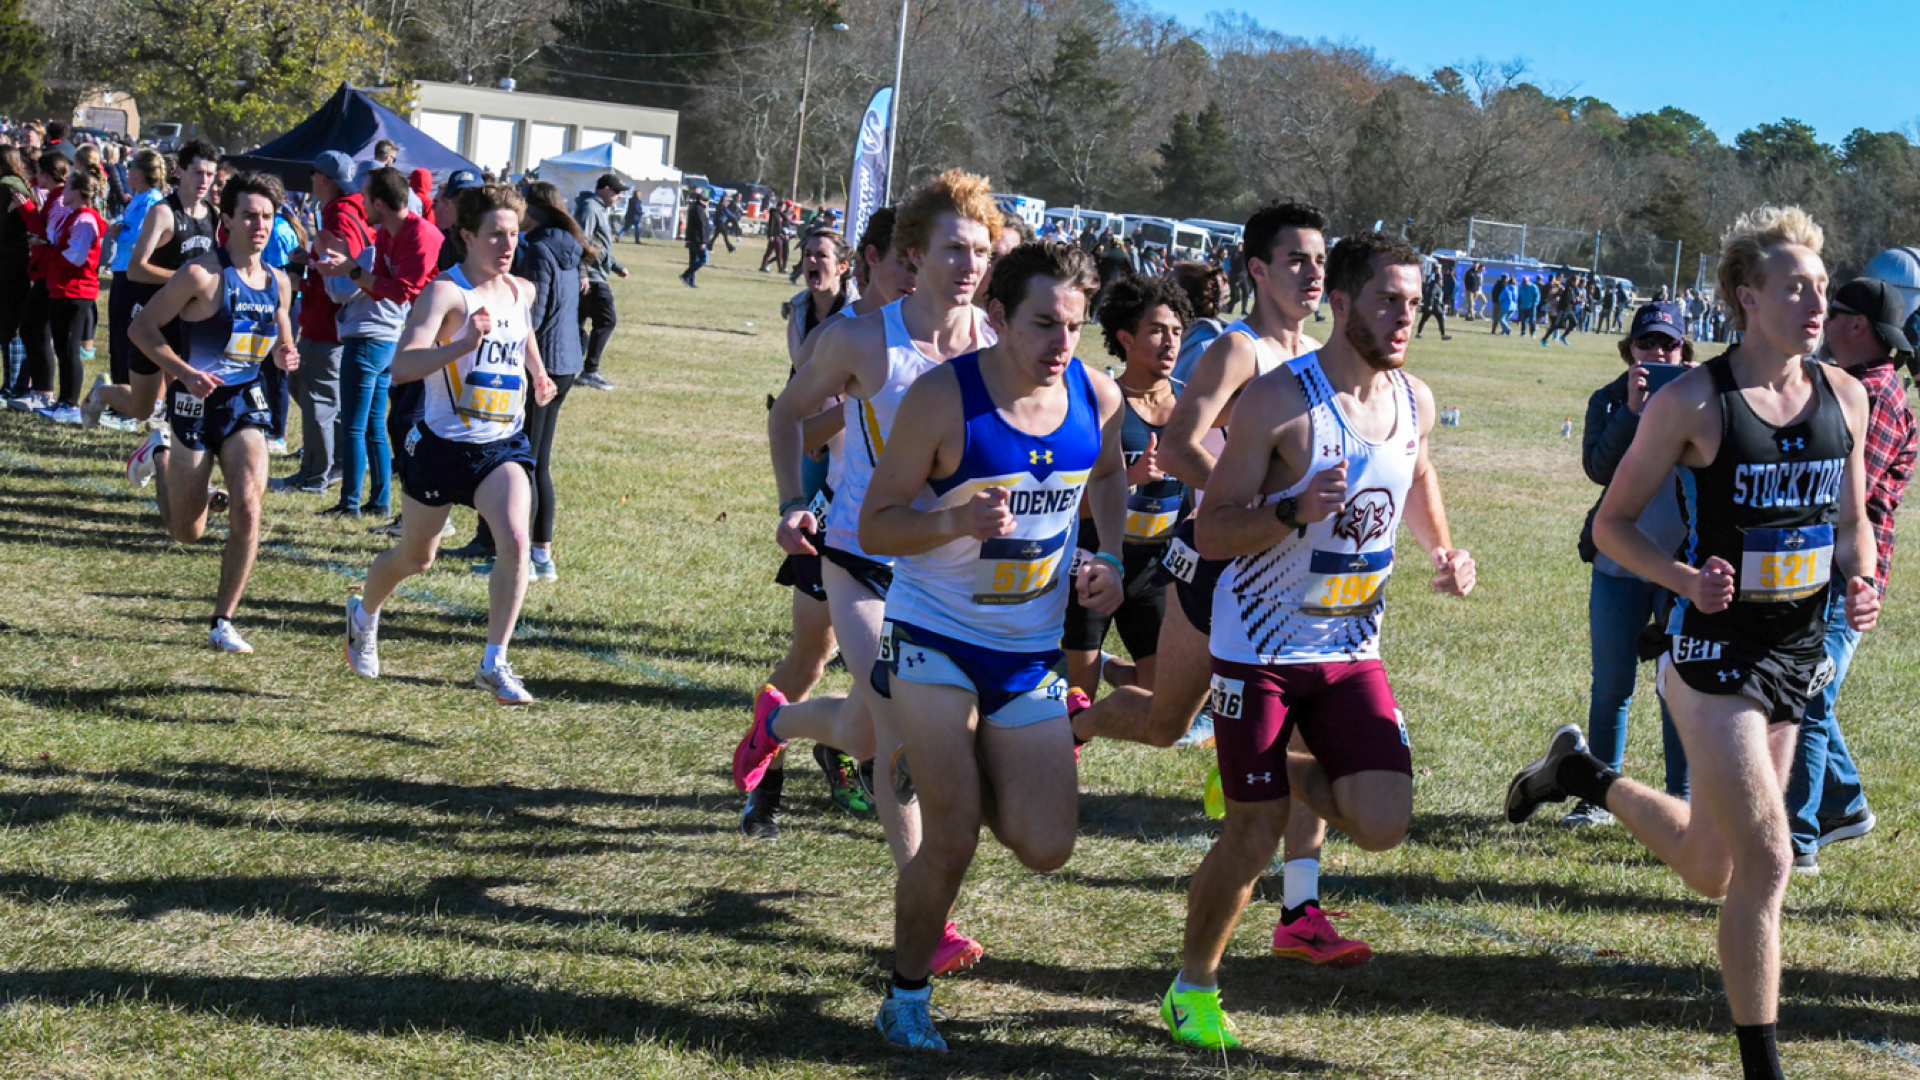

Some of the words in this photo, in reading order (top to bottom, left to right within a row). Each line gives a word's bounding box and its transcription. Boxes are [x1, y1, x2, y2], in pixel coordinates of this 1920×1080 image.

[854, 166, 871, 251] TOCKTON
[176, 400, 203, 416] 442
[471, 388, 511, 413] 536
[1733, 458, 1846, 507] STOCKTON
[1004, 485, 1081, 516] IDENE
[1125, 513, 1168, 535] 426
[993, 557, 1053, 592] 575
[1760, 552, 1817, 588] 521
[1321, 574, 1379, 606] 396
